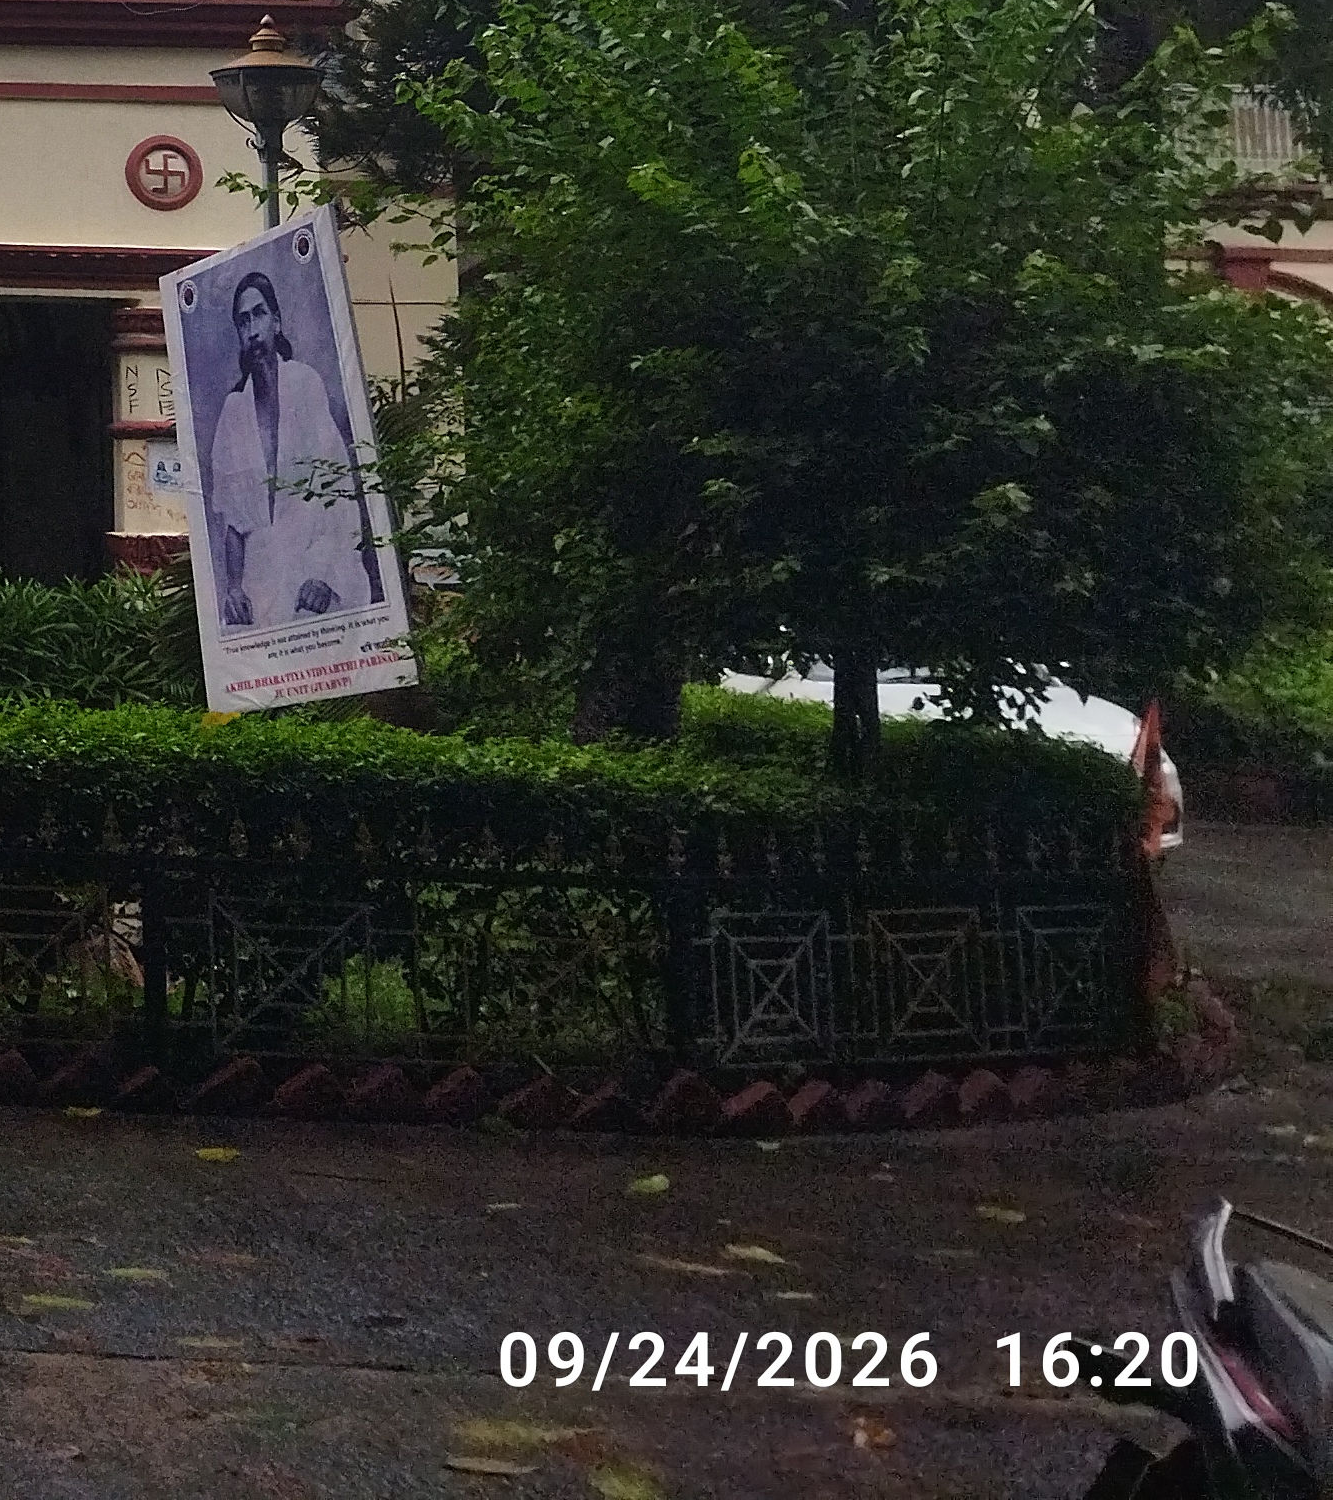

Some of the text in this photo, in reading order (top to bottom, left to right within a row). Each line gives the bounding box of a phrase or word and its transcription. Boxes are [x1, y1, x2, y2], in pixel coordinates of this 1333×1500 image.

[125, 365, 139, 414] NSF
[240, 640, 271, 654] knowledge
[312, 630, 320, 639] by
[362, 618, 378, 628] what
[378, 615, 390, 626] you
[290, 645, 305, 655] what
[305, 644, 316, 655] you
[225, 680, 254, 693] AKHIL
[255, 671, 306, 688] BHARATIYA
[306, 660, 357, 679] VIDYARTHI
[285, 685, 309, 697] UNIT
